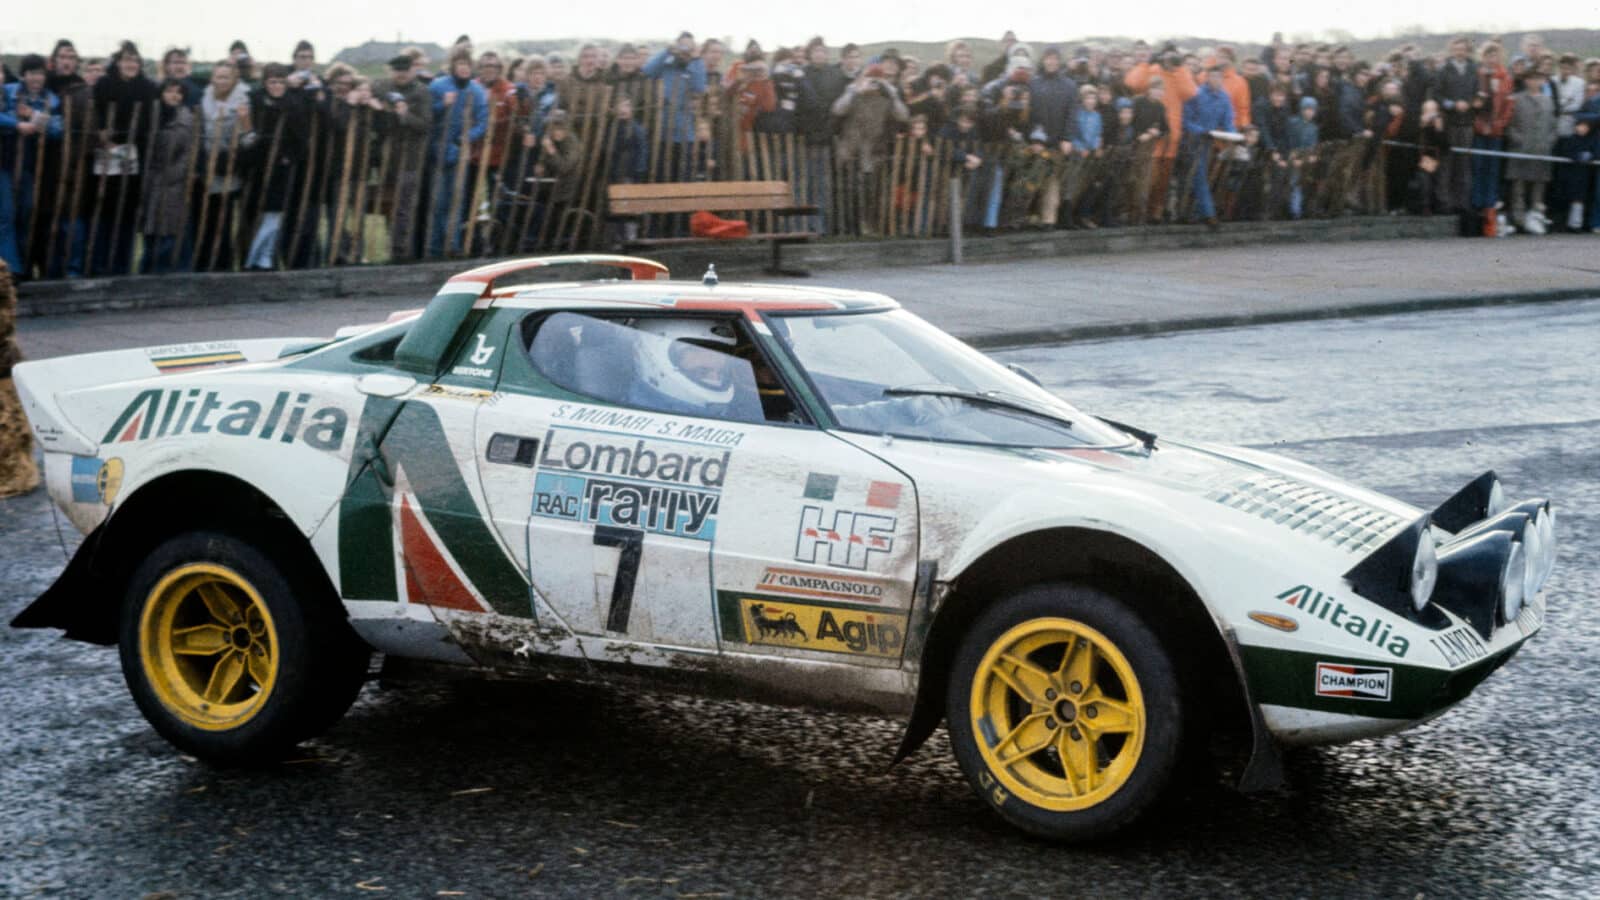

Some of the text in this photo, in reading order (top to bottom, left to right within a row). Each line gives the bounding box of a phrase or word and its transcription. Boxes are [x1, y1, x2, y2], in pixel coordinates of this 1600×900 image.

[101, 388, 350, 452] Alitalia
[570, 407, 655, 432] MUNARI
[677, 424, 746, 447] MAIGA
[539, 430, 732, 488] Lombard
[535, 482, 718, 535] RAC rally
[794, 504, 897, 571] HF
[592, 524, 645, 634] 7
[778, 575, 883, 597] CAMPAGNOLO
[815, 610, 901, 652] Agip
[1275, 584, 1411, 659] Alitalia
[1320, 673, 1386, 690] CHAMPION
